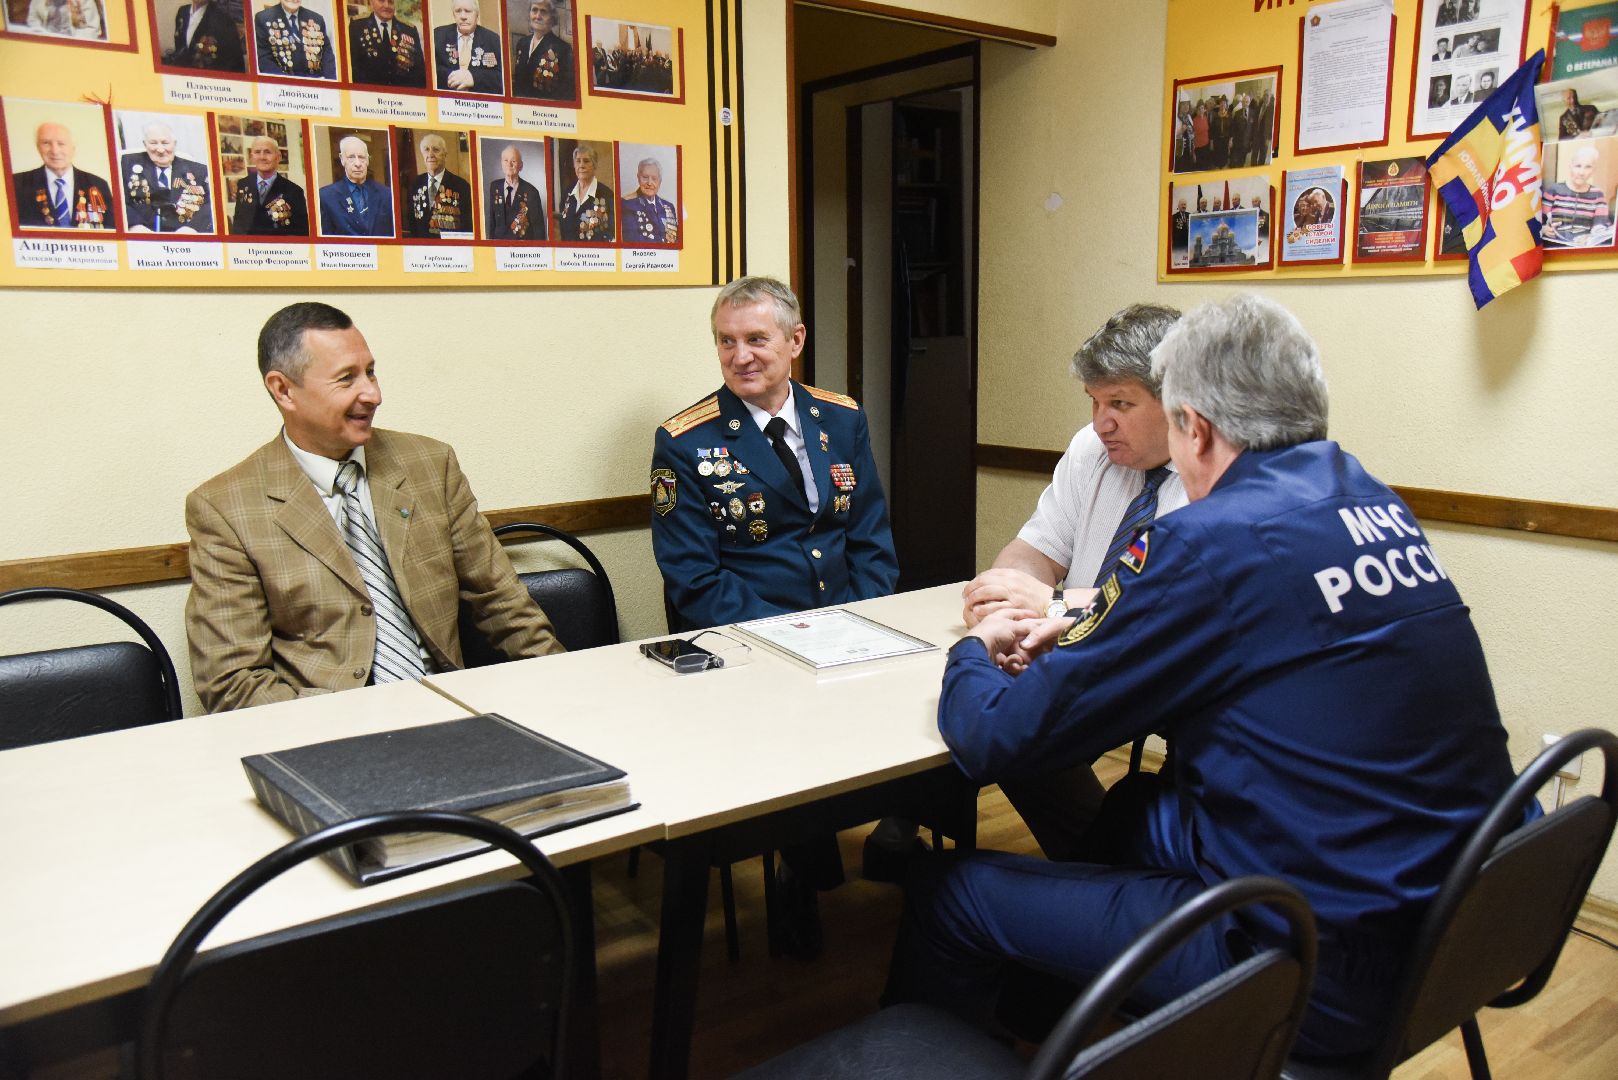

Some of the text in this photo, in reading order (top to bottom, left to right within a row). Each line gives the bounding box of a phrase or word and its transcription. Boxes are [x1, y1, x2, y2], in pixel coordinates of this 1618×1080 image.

[170, 89, 248, 105] Вера Григорьевна
[278, 88, 319, 100] Двойкин
[377, 97, 403, 108] Ветров
[355, 106, 426, 118] Николай Иванович
[1307, 223, 1334, 231] СОВЕТЫ
[19, 239, 105, 254] Андриянов
[1305, 238, 1336, 246] СИДЕЛКИ
[162, 245, 192, 254] Чусов
[322, 249, 371, 259] Кривошеев
[21, 255, 63, 263] Александр
[137, 258, 219, 268] Иван Антонович
[233, 257, 263, 267] Виктор
[1338, 503, 1420, 546] МЧС
[1313, 544, 1447, 614] РОССИ
